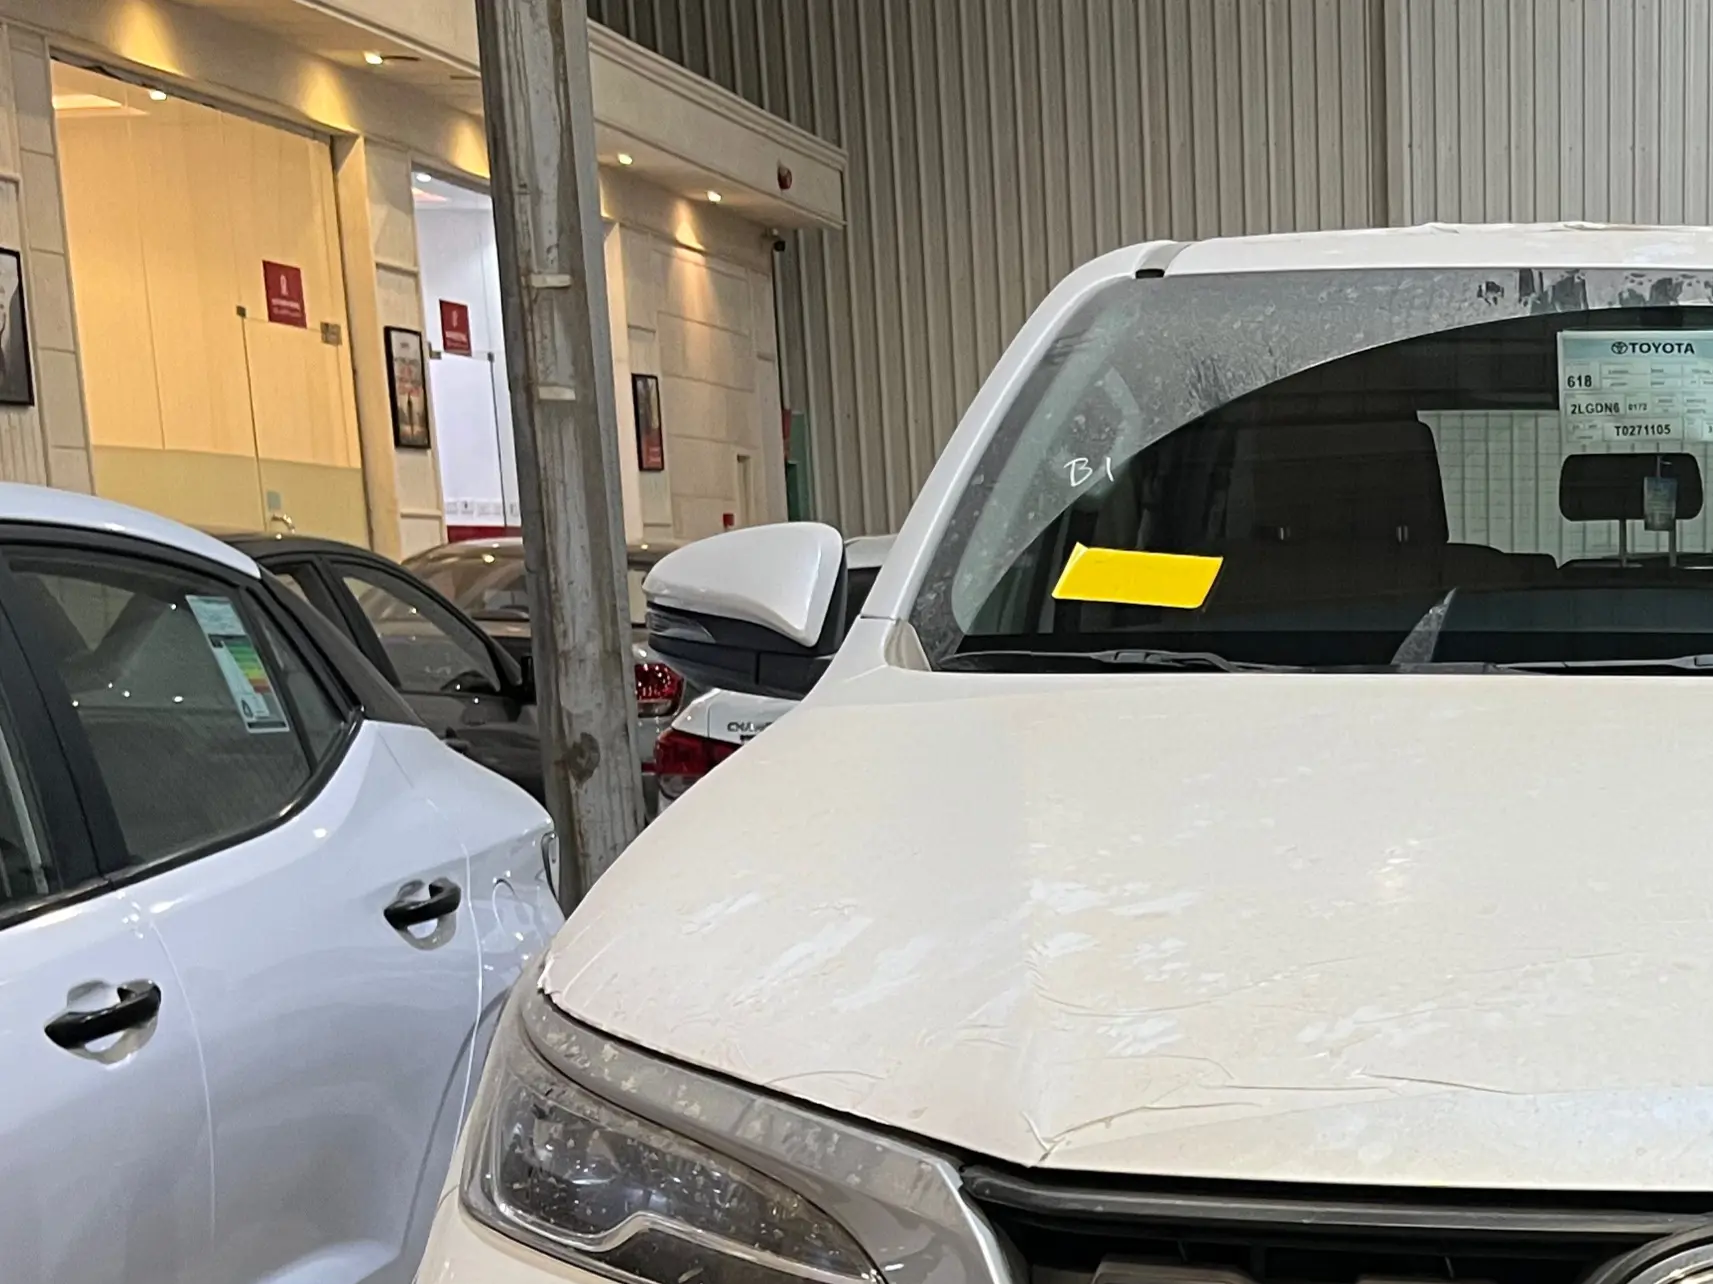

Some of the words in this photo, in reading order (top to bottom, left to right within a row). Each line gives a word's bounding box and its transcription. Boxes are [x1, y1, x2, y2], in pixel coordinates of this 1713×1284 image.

[1628, 342, 1695, 355] TOYOTA
[1567, 374, 1592, 388] 618
[1614, 424, 1671, 437] T0271105
